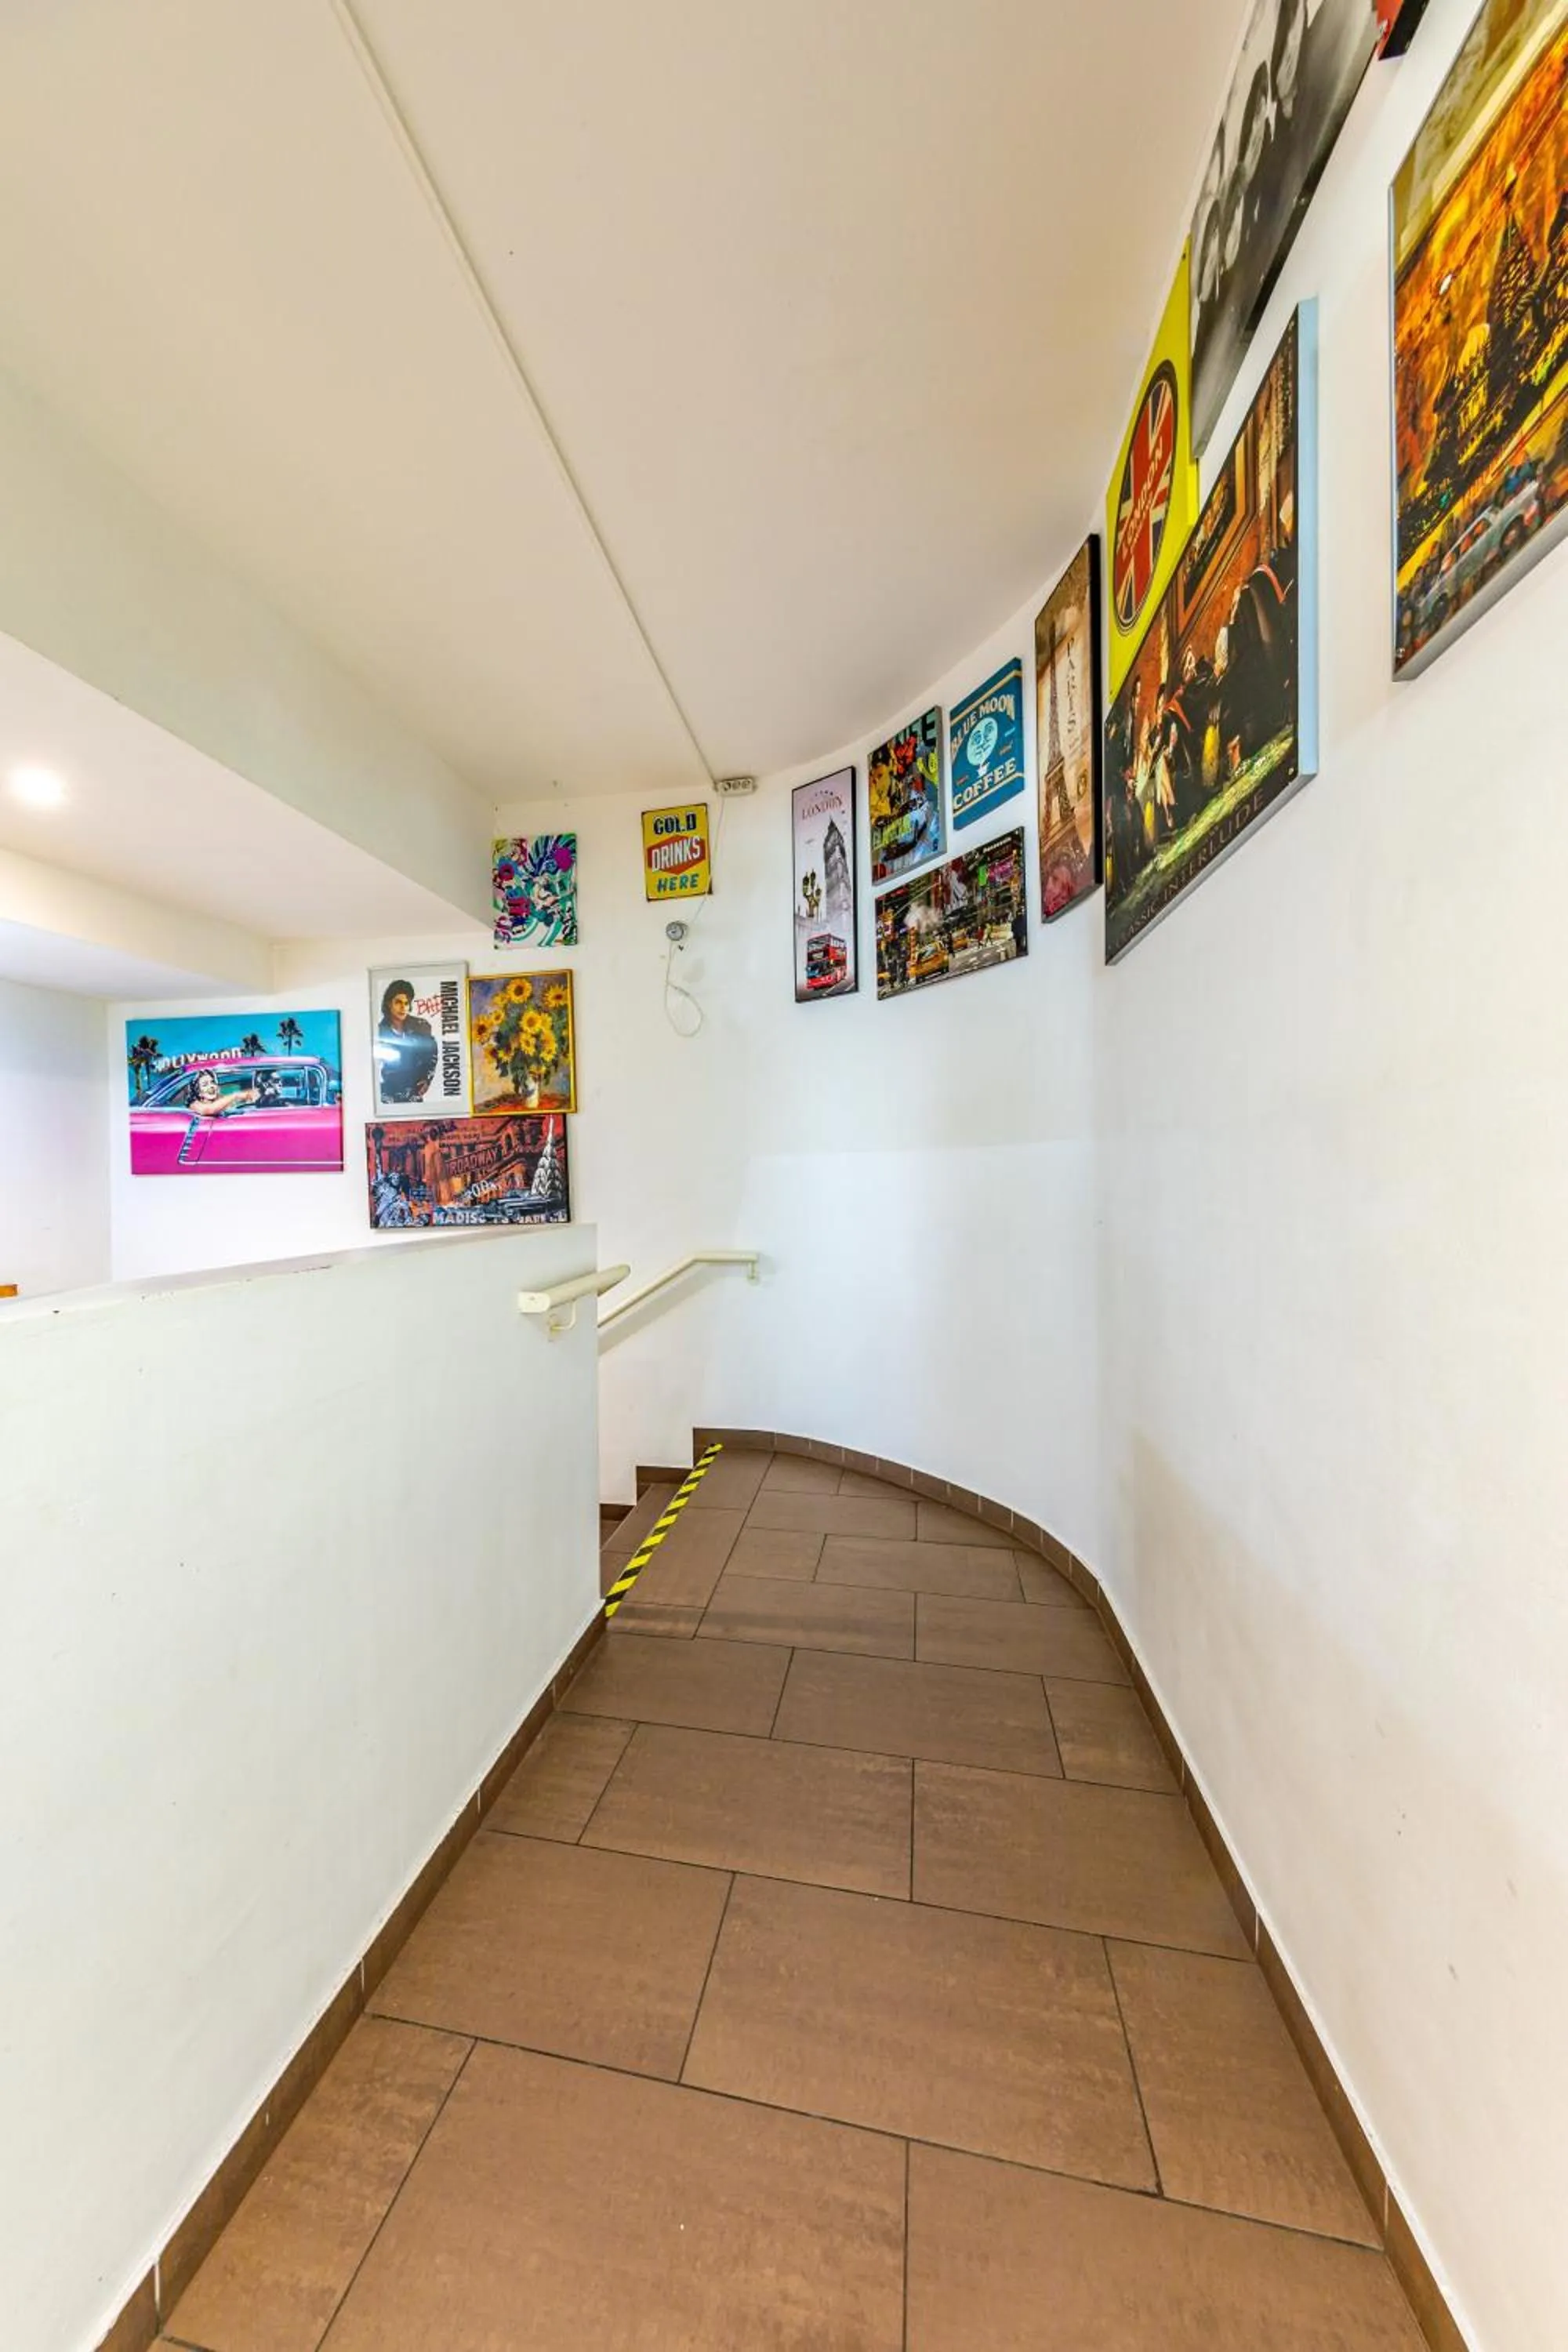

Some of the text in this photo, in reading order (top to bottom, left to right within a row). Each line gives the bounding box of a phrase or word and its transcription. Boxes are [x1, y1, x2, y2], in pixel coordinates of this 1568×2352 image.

[1066, 636, 1077, 735] PARIS
[950, 712, 978, 766] BLUE
[979, 694, 1015, 721] MOON
[953, 757, 1018, 809] COFFEE
[652, 836, 701, 873] DRINKS
[653, 812, 697, 835] COLD
[1163, 787, 1265, 901] INTERLUDE
[657, 873, 699, 893] HERE
[440, 981, 462, 1097] MICHAEL JACKSON
